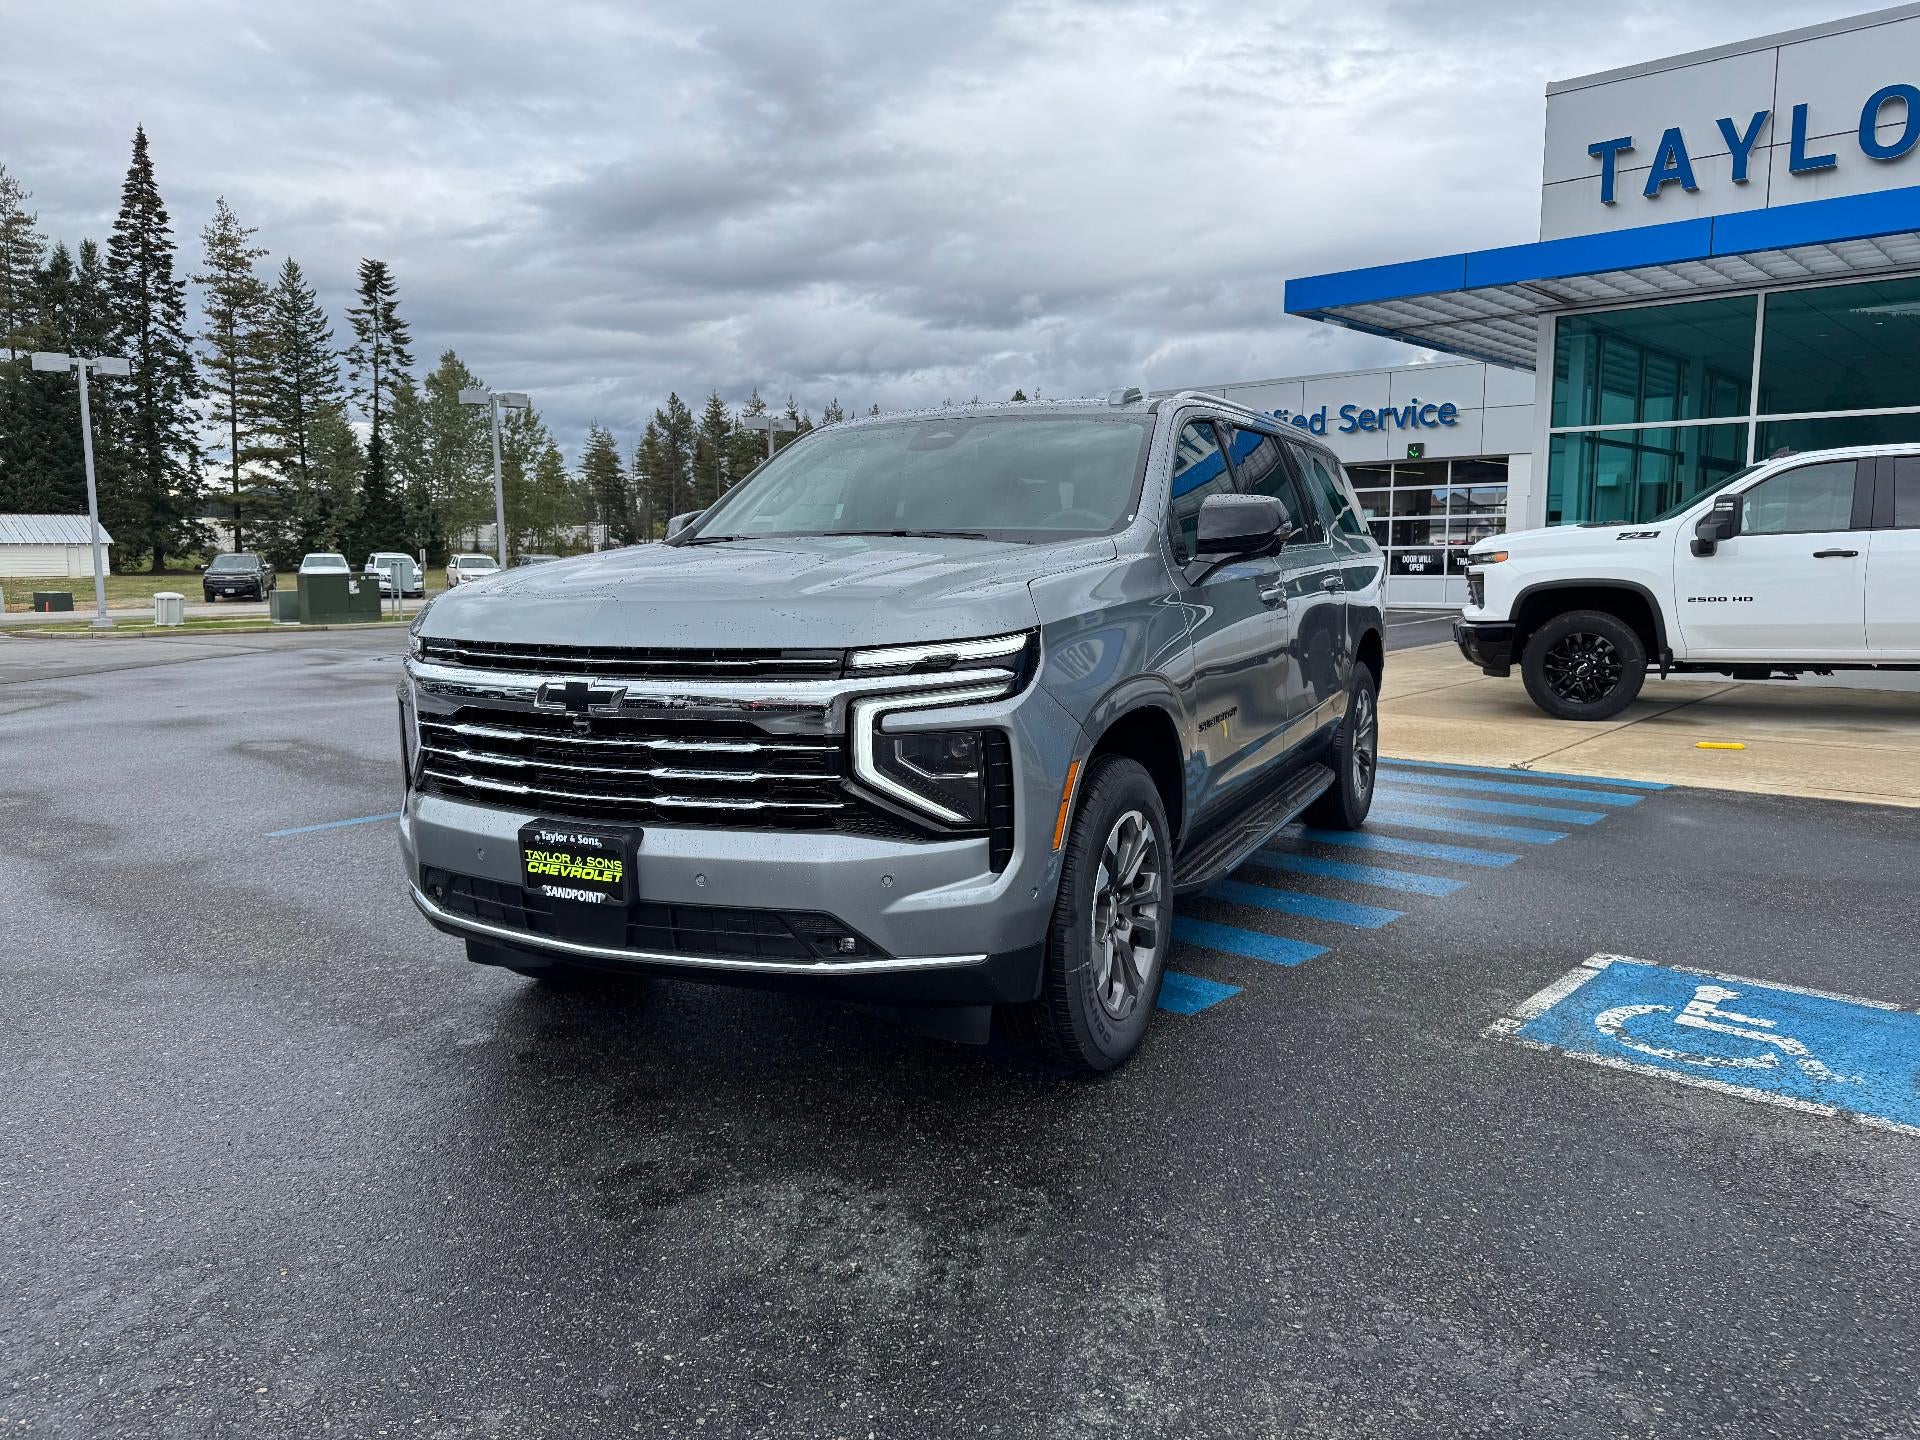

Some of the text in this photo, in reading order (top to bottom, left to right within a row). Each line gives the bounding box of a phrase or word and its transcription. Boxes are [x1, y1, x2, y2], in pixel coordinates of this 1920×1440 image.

[1588, 84, 1920, 206] TAYLO
[1338, 398, 1458, 434] Service
[1402, 555, 1432, 564] DOOR WILL
[1409, 563, 1424, 572] OPEN
[540, 831, 599, 846] Taylor & Sons
[525, 850, 623, 870] TAYLOR & SONS
[527, 862, 622, 882] CHEVROLET
[545, 885, 604, 904] SANDPOINT
